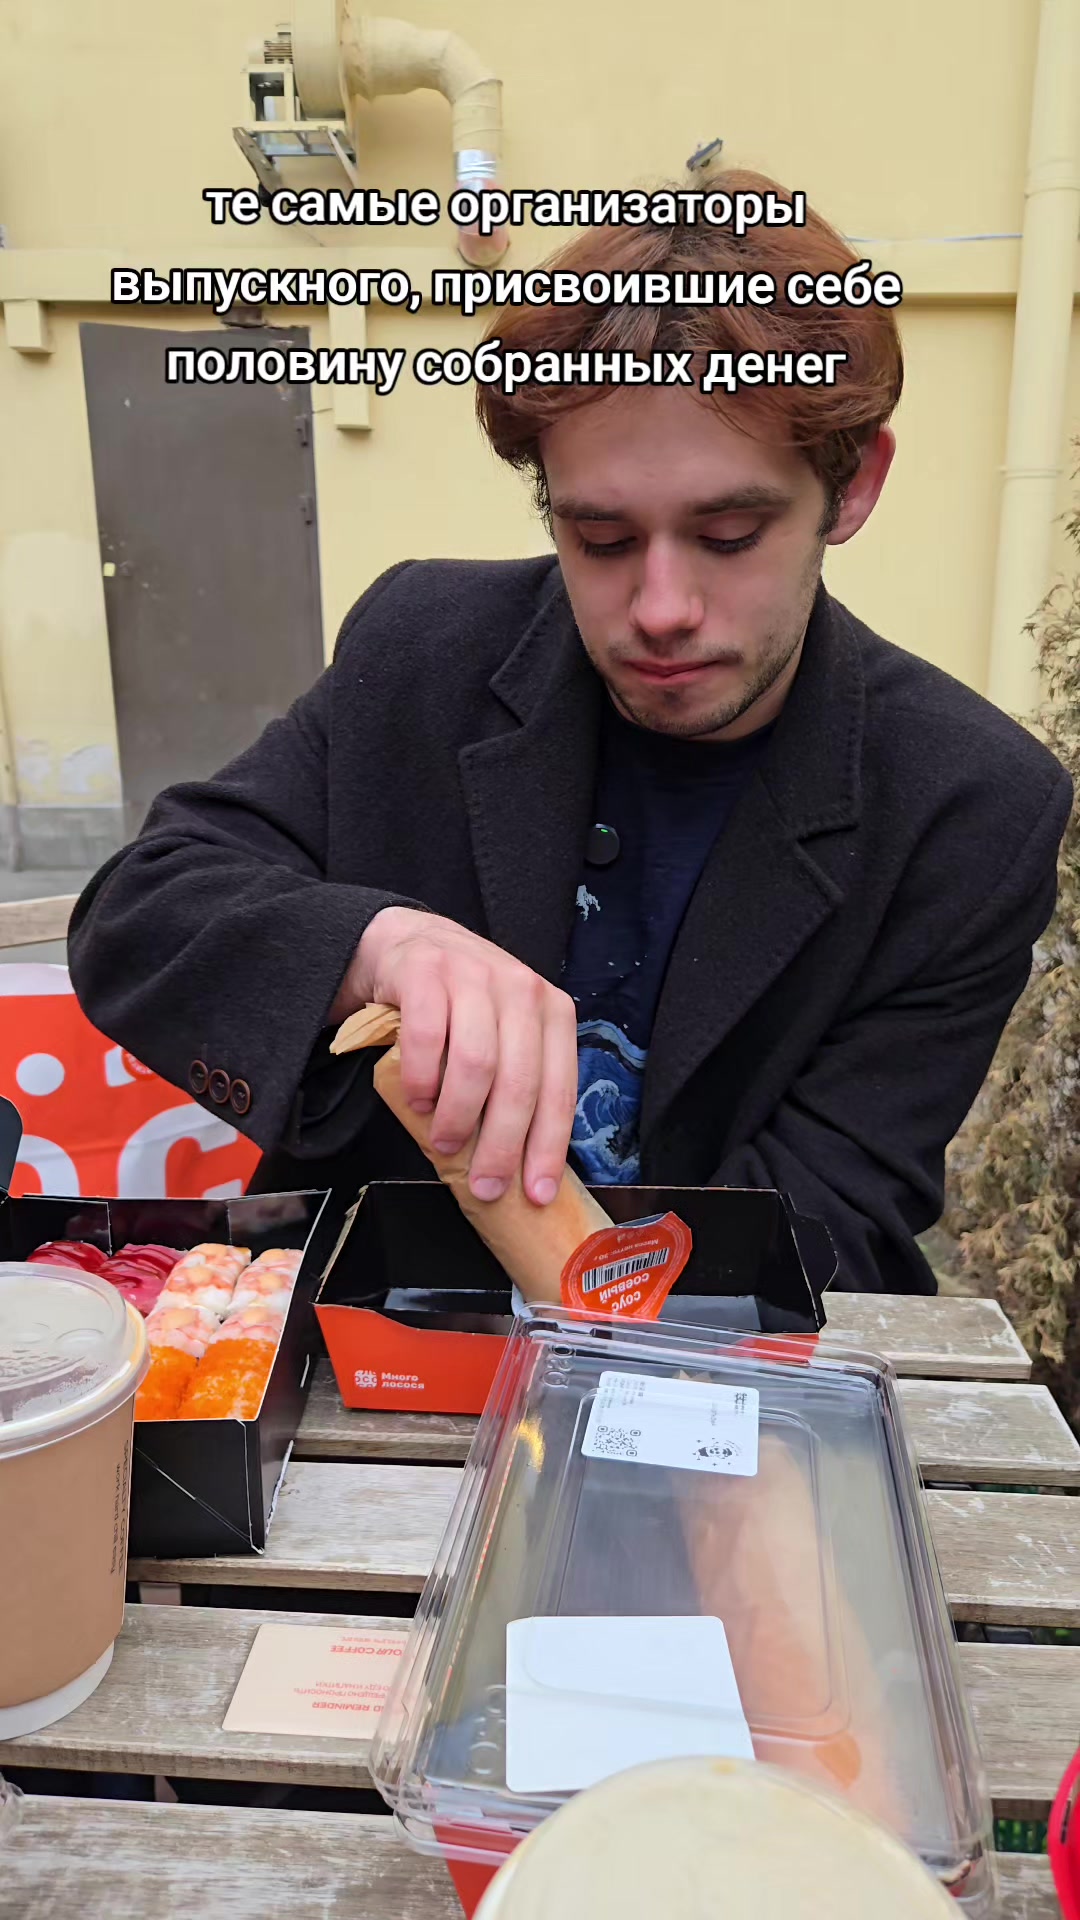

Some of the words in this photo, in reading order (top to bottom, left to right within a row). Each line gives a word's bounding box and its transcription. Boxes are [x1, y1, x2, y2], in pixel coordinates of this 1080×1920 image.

[599, 1272, 650, 1304] соевый
[611, 1291, 641, 1313] соус
[381, 1372, 419, 1382] Много
[381, 1381, 425, 1389] лосося
[330, 1645, 375, 1655] COFFEE
[312, 1701, 371, 1712] REMINDER
